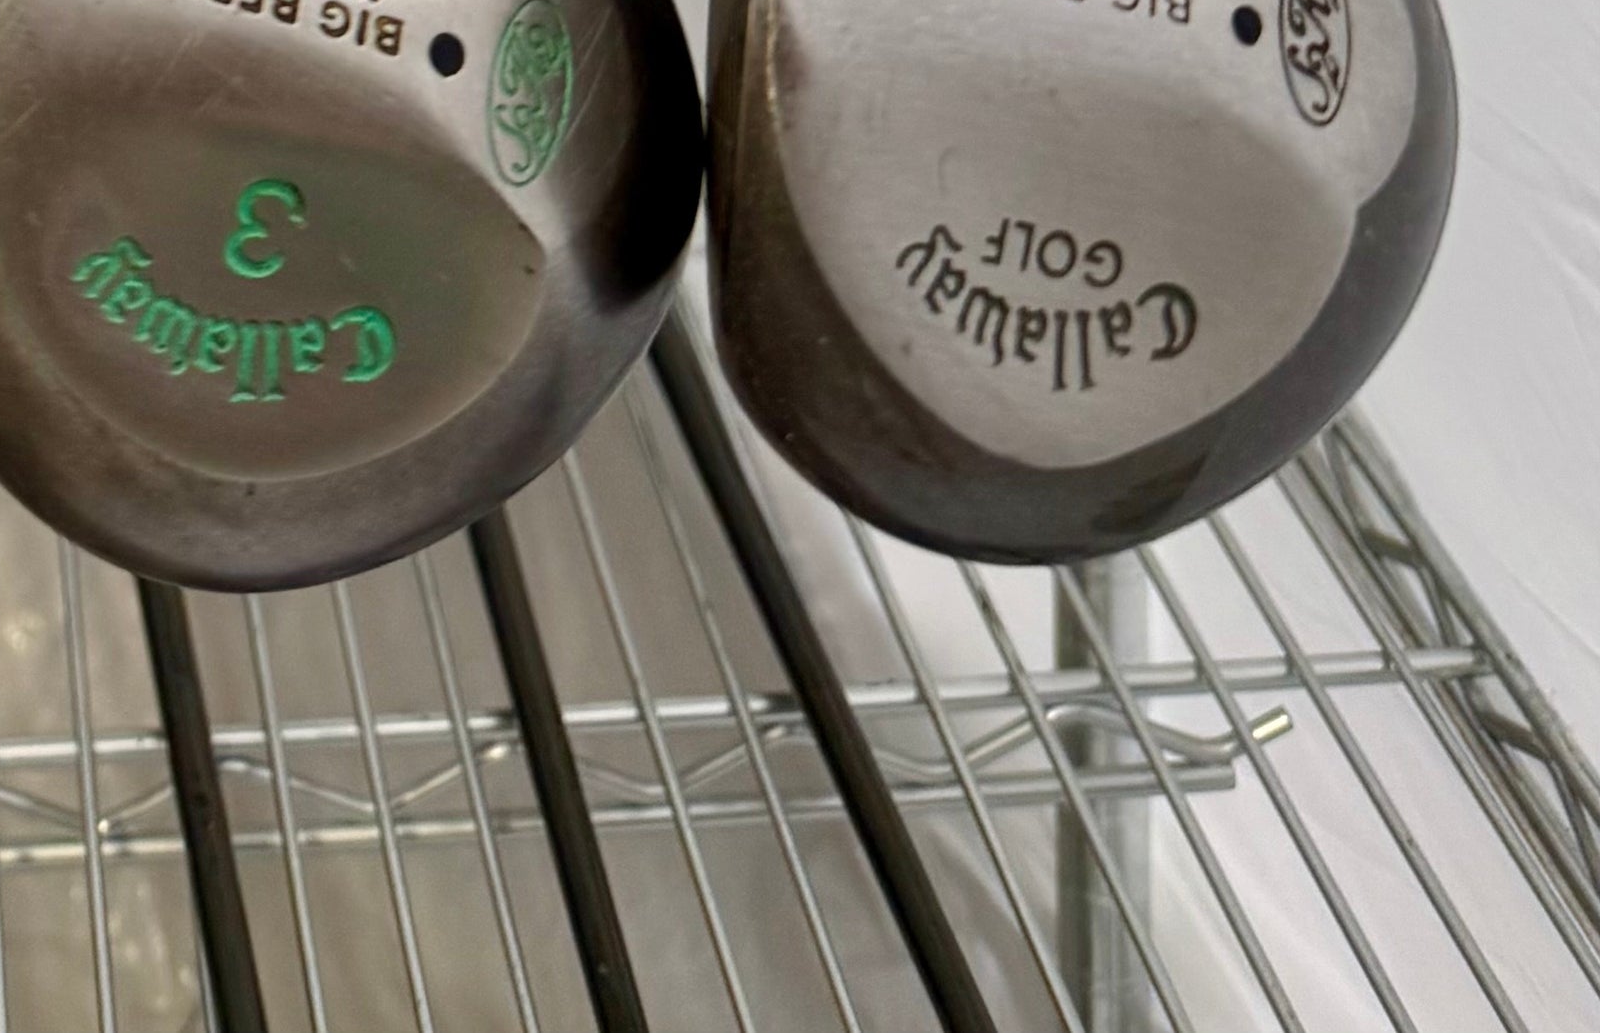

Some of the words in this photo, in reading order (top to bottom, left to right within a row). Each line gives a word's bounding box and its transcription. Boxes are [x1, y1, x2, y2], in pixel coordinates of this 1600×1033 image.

[319, 0, 405, 56] BIG
[223, 178, 307, 279] 3
[980, 218, 1123, 288] GOLF
[70, 235, 395, 404] Callaway
[895, 224, 1198, 393] Callaway
